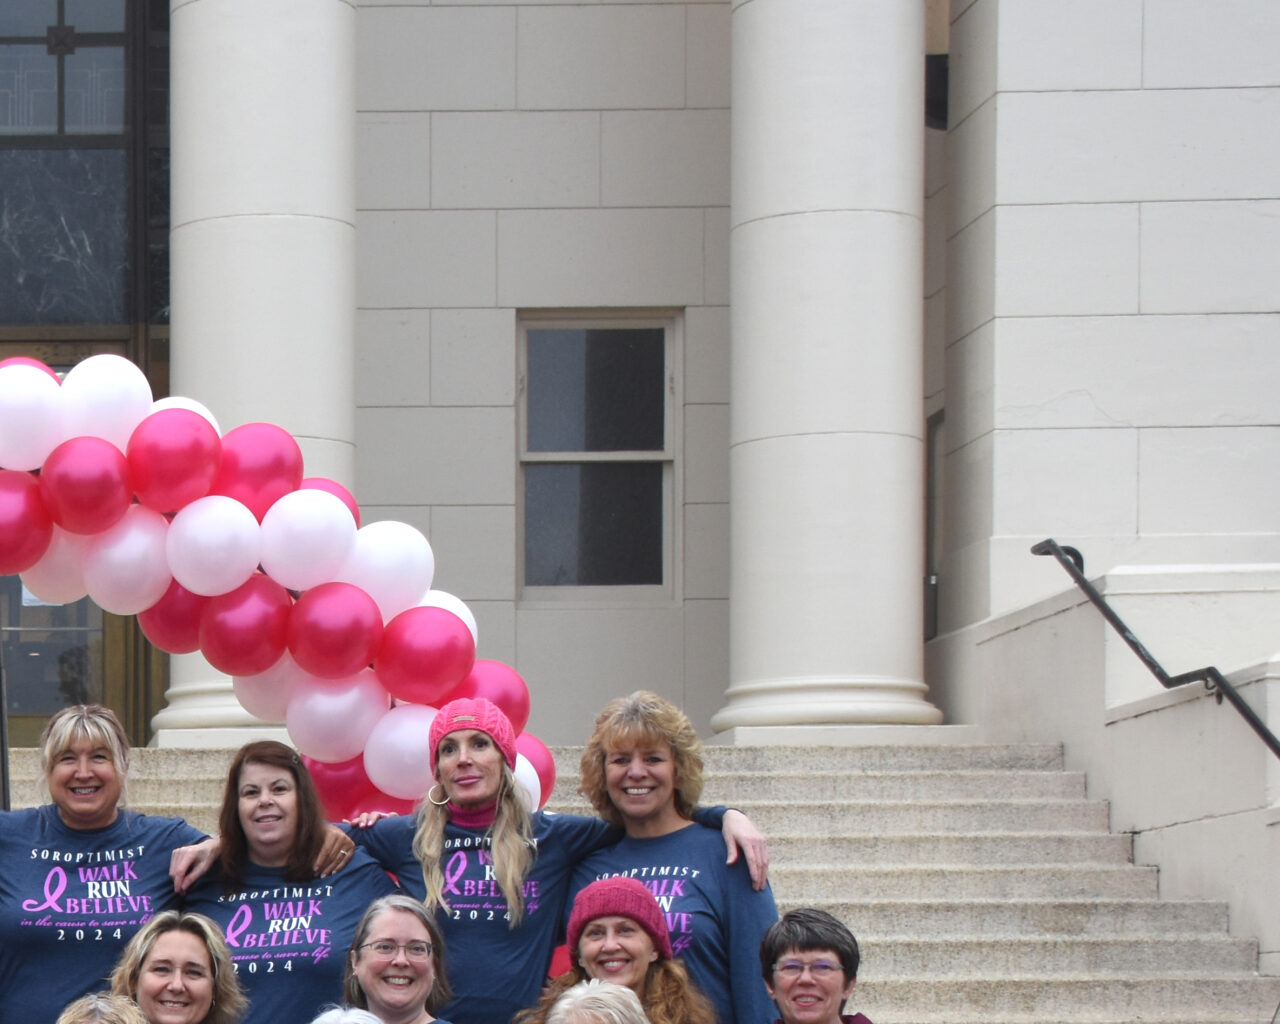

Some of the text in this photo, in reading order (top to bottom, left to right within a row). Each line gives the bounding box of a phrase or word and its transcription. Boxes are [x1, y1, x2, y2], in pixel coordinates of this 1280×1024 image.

[31, 846, 144, 863] SOROPTIMIST
[78, 861, 138, 883] WALK
[87, 880, 130, 898] RUN
[218, 885, 332, 902] SOROPTIMIST
[464, 880, 540, 898] BELVE
[66, 896, 153, 914] BELIEVE
[264, 900, 322, 920] WALK
[21, 918, 32, 926] in
[35, 915, 52, 926] the
[268, 916, 312, 933] RUN
[453, 910, 511, 921] 2024
[57, 929, 121, 940] 2024
[243, 929, 332, 948] BELIEVE
[311, 946, 331, 964] life
